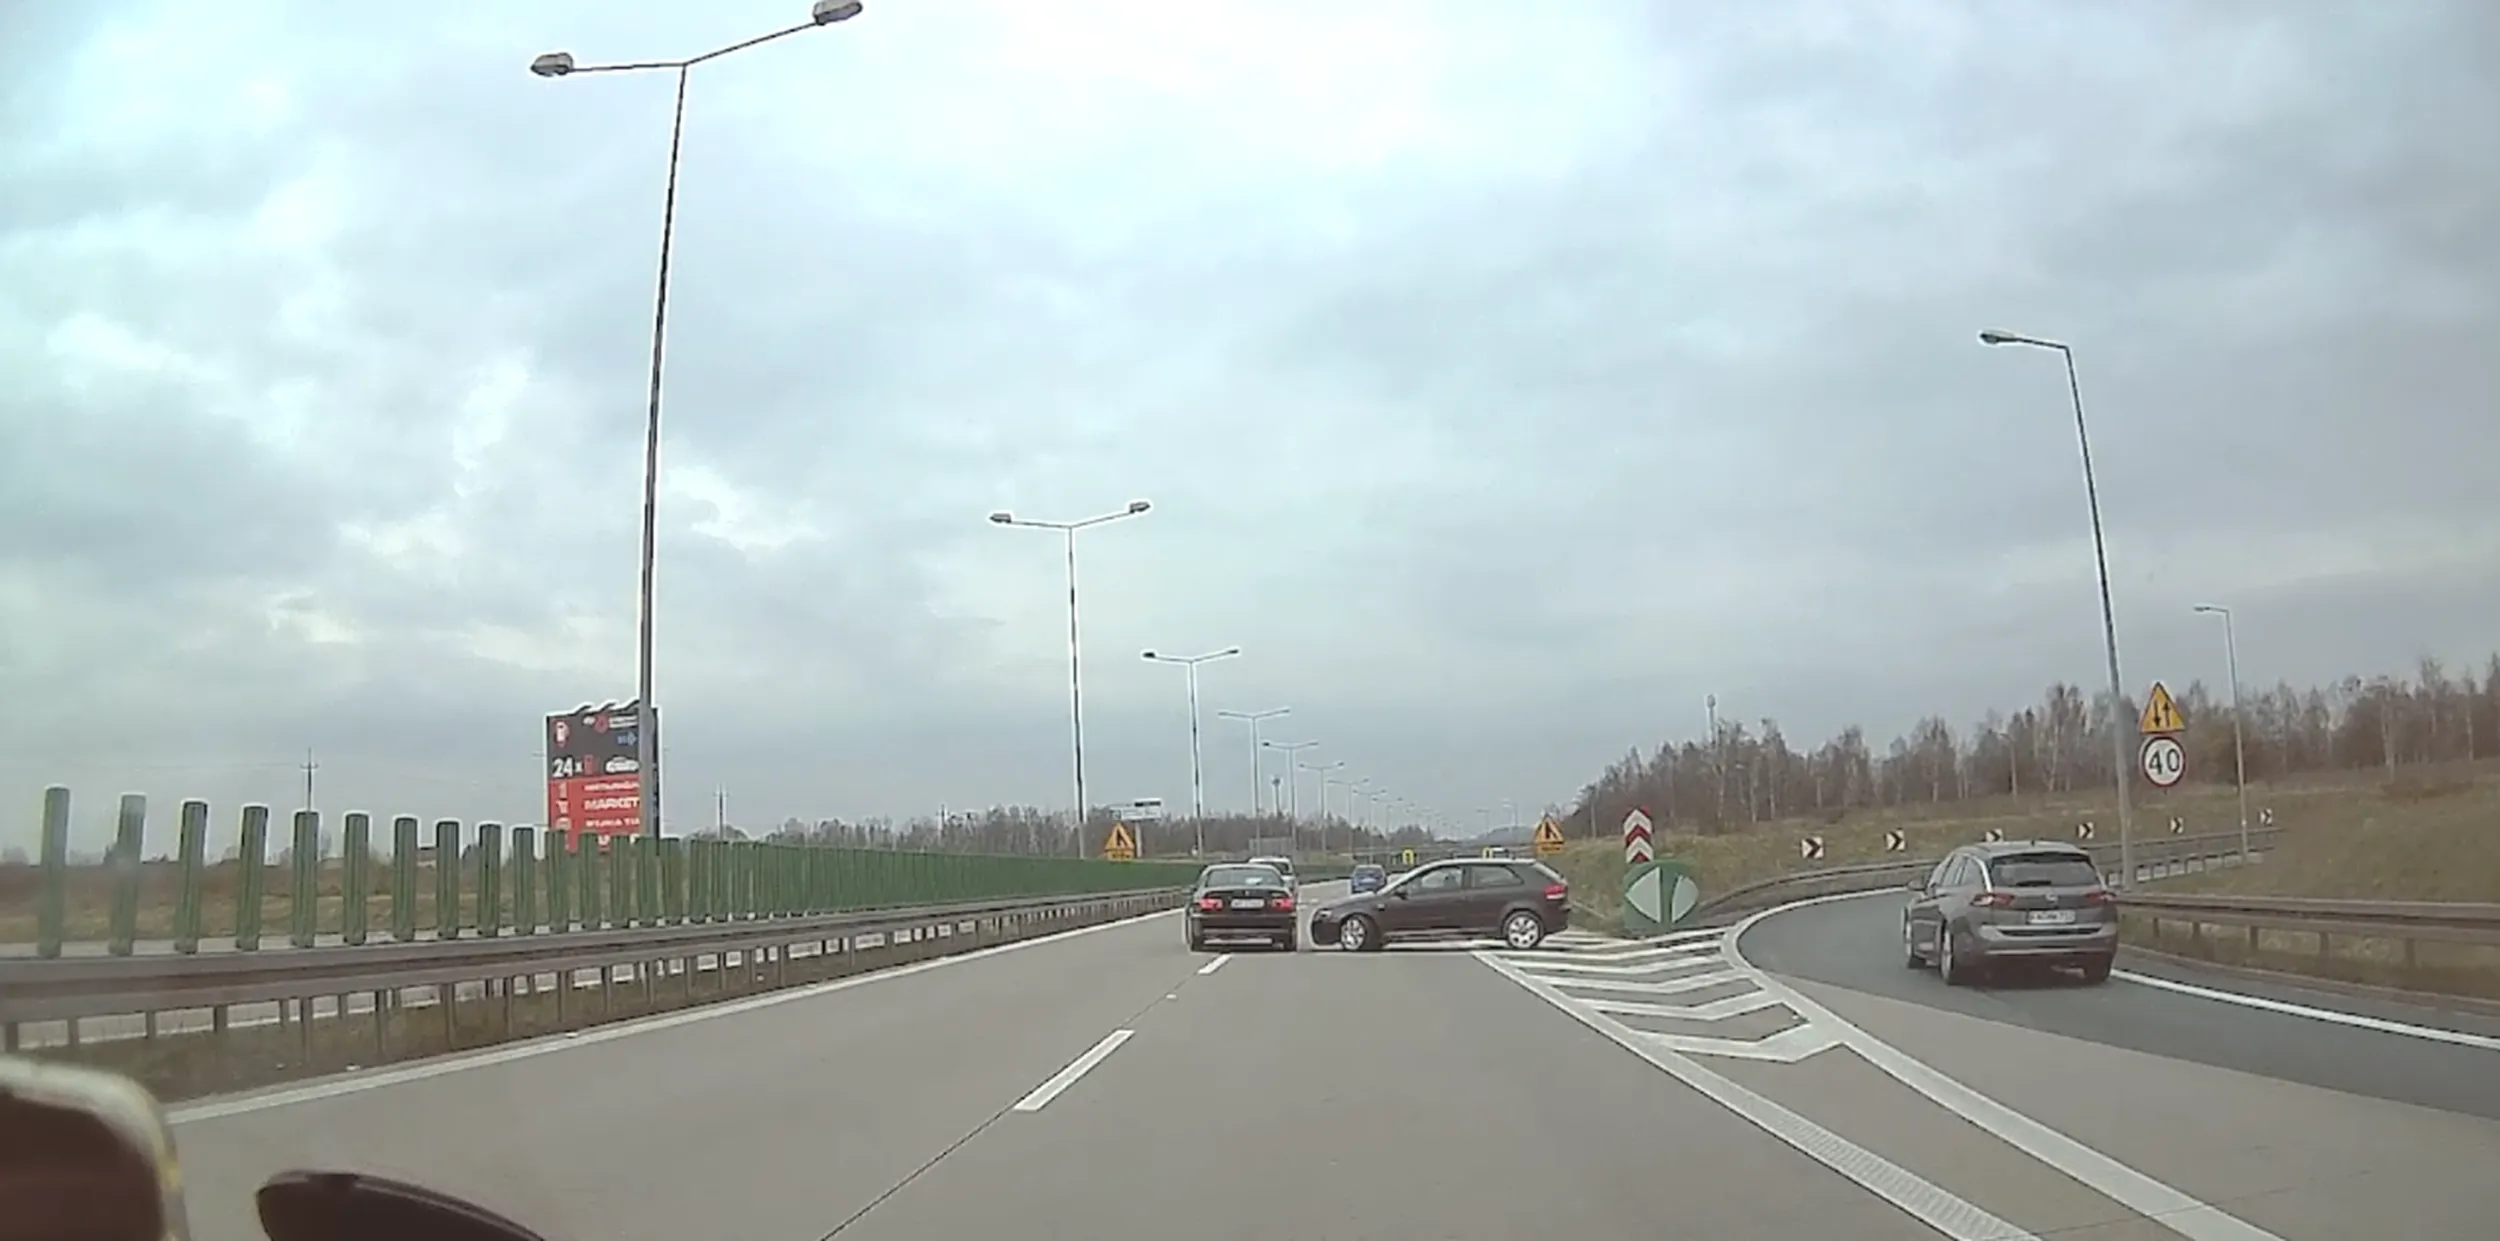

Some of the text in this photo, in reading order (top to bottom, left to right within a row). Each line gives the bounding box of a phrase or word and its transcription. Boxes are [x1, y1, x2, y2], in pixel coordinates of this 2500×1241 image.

[552, 757, 573, 778] 24
[2148, 748, 2180, 775] 40
[584, 796, 640, 811] MARKET
